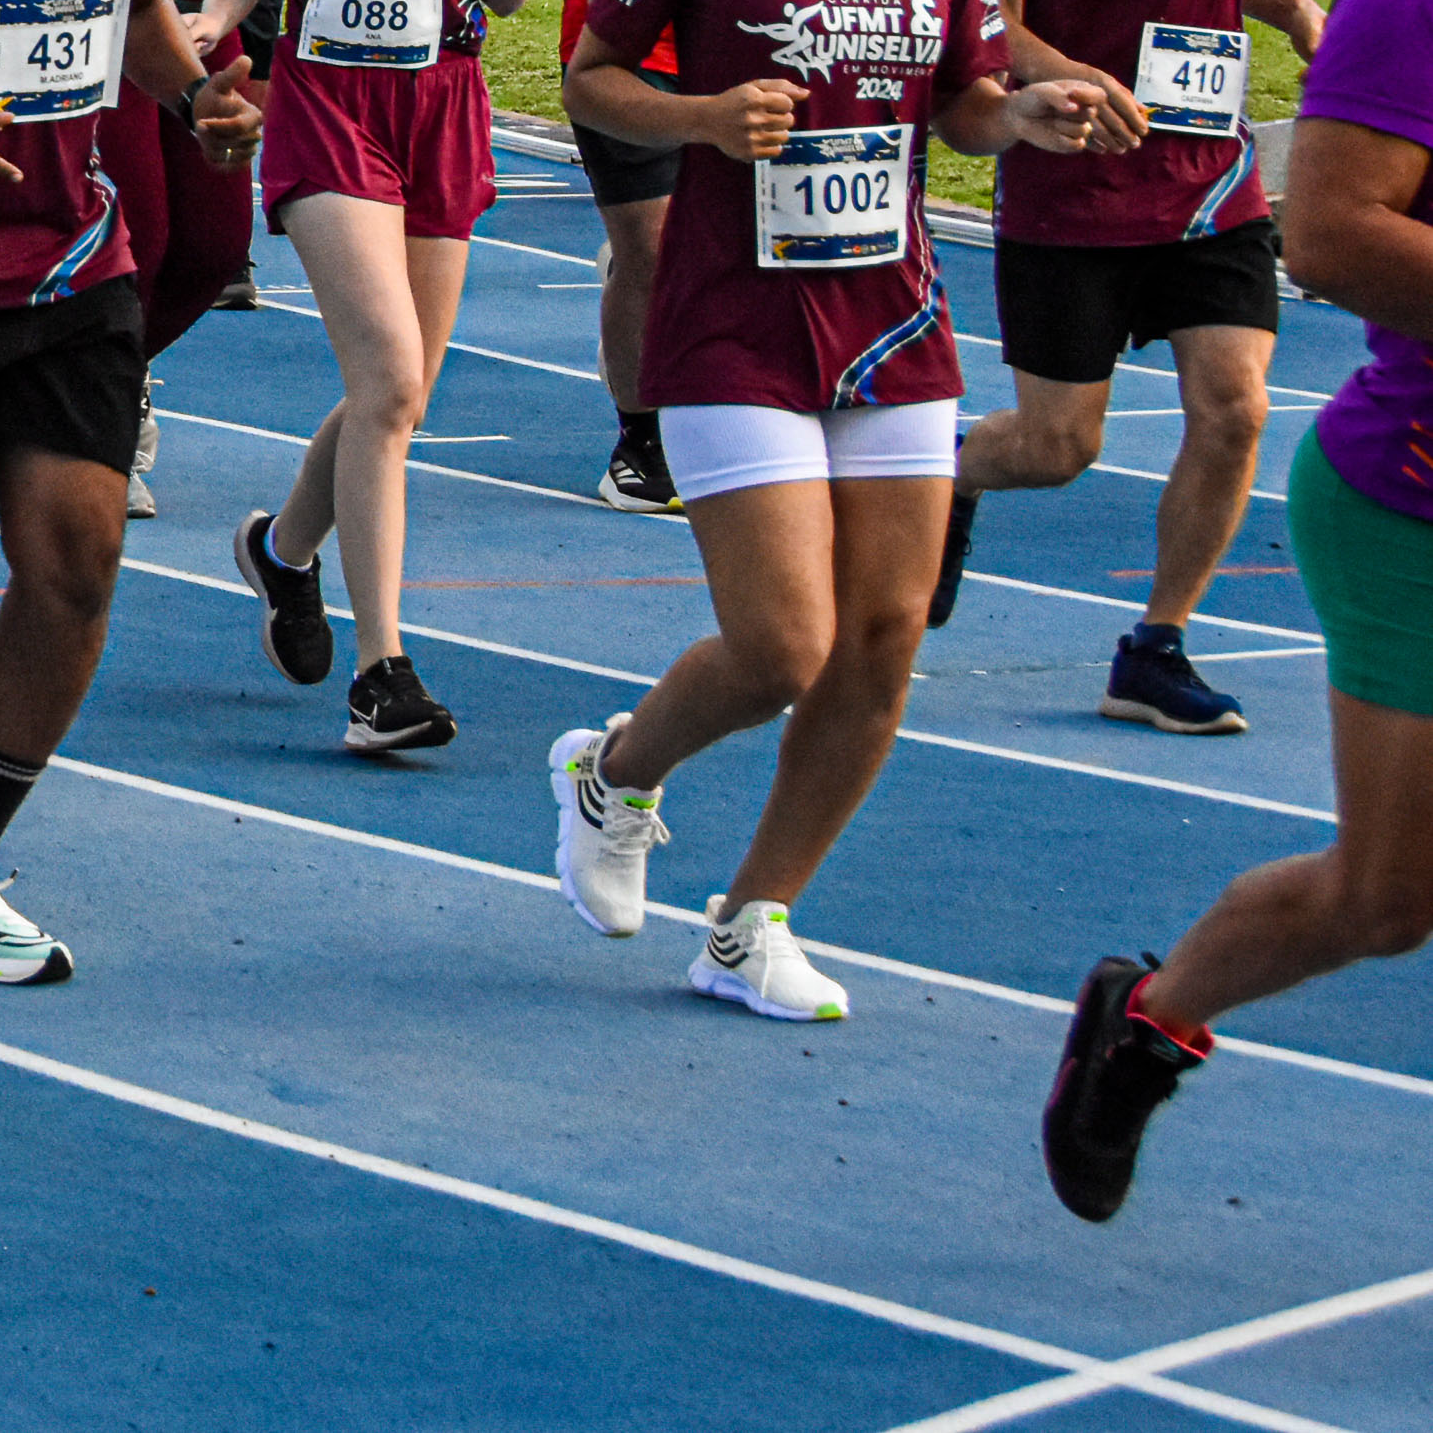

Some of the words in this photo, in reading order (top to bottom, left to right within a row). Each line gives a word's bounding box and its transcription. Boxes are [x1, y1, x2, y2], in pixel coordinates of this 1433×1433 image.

[821, 6, 904, 34] UFMT
[28, 28, 91, 71] 431
[843, 64, 860, 74] EM
[1172, 60, 1225, 94] 410
[856, 77, 903, 101] 2024
[794, 169, 890, 215] 1002
